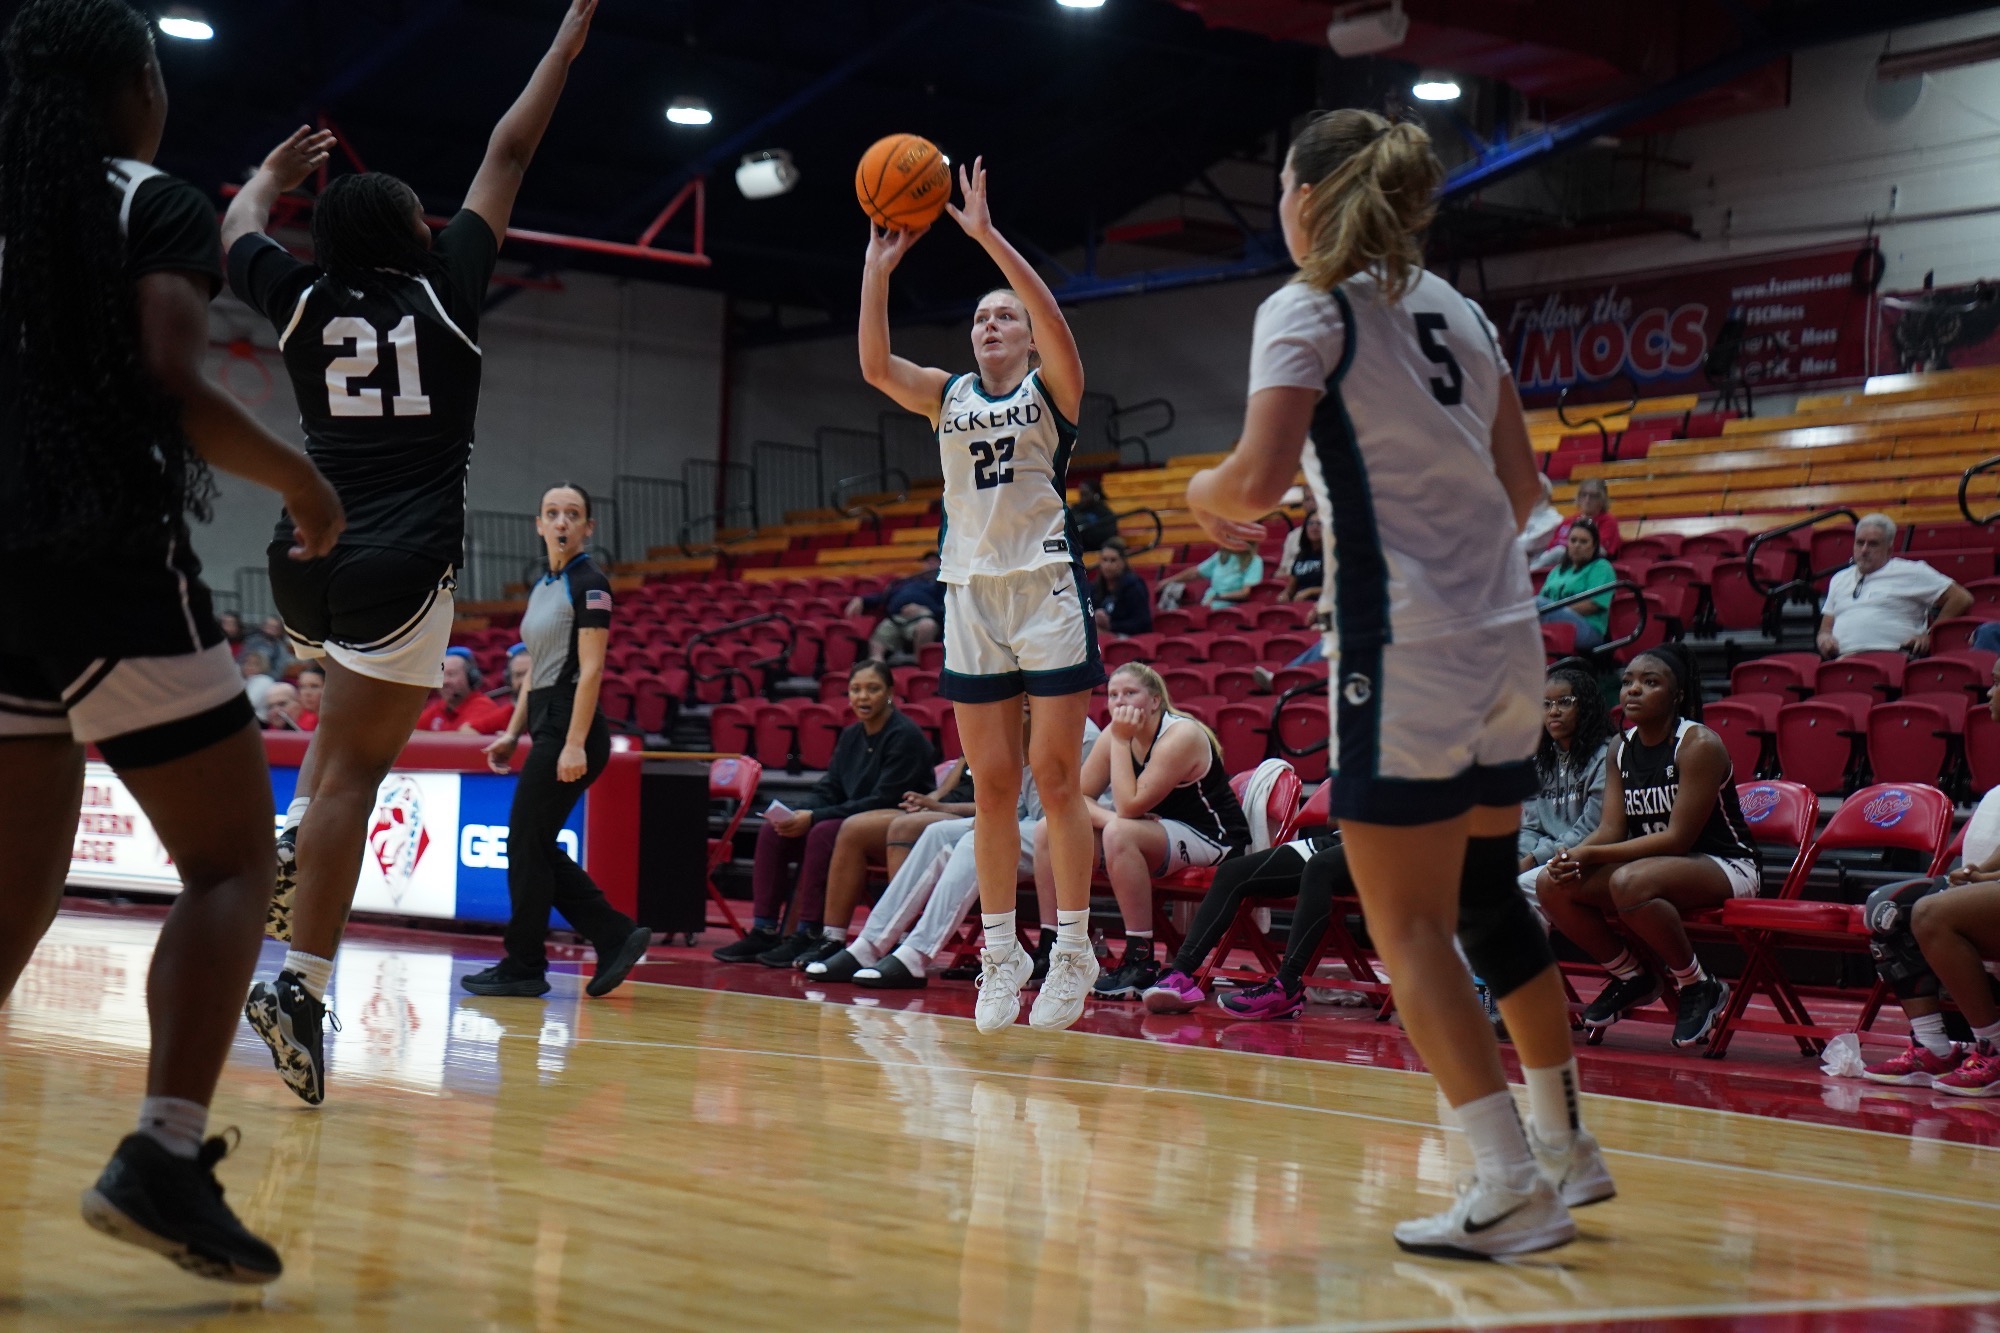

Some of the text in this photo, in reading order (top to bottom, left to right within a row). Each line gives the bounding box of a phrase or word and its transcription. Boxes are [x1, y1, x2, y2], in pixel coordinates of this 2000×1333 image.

[1508, 284, 1633, 333] Follow the
[322, 315, 432, 417] 21
[1413, 312, 1463, 406] 5
[1517, 303, 1709, 387] MOCS
[943, 403, 1043, 434] ECKERD
[969, 436, 1016, 491] 22
[1863, 794, 1913, 821] Mocs
